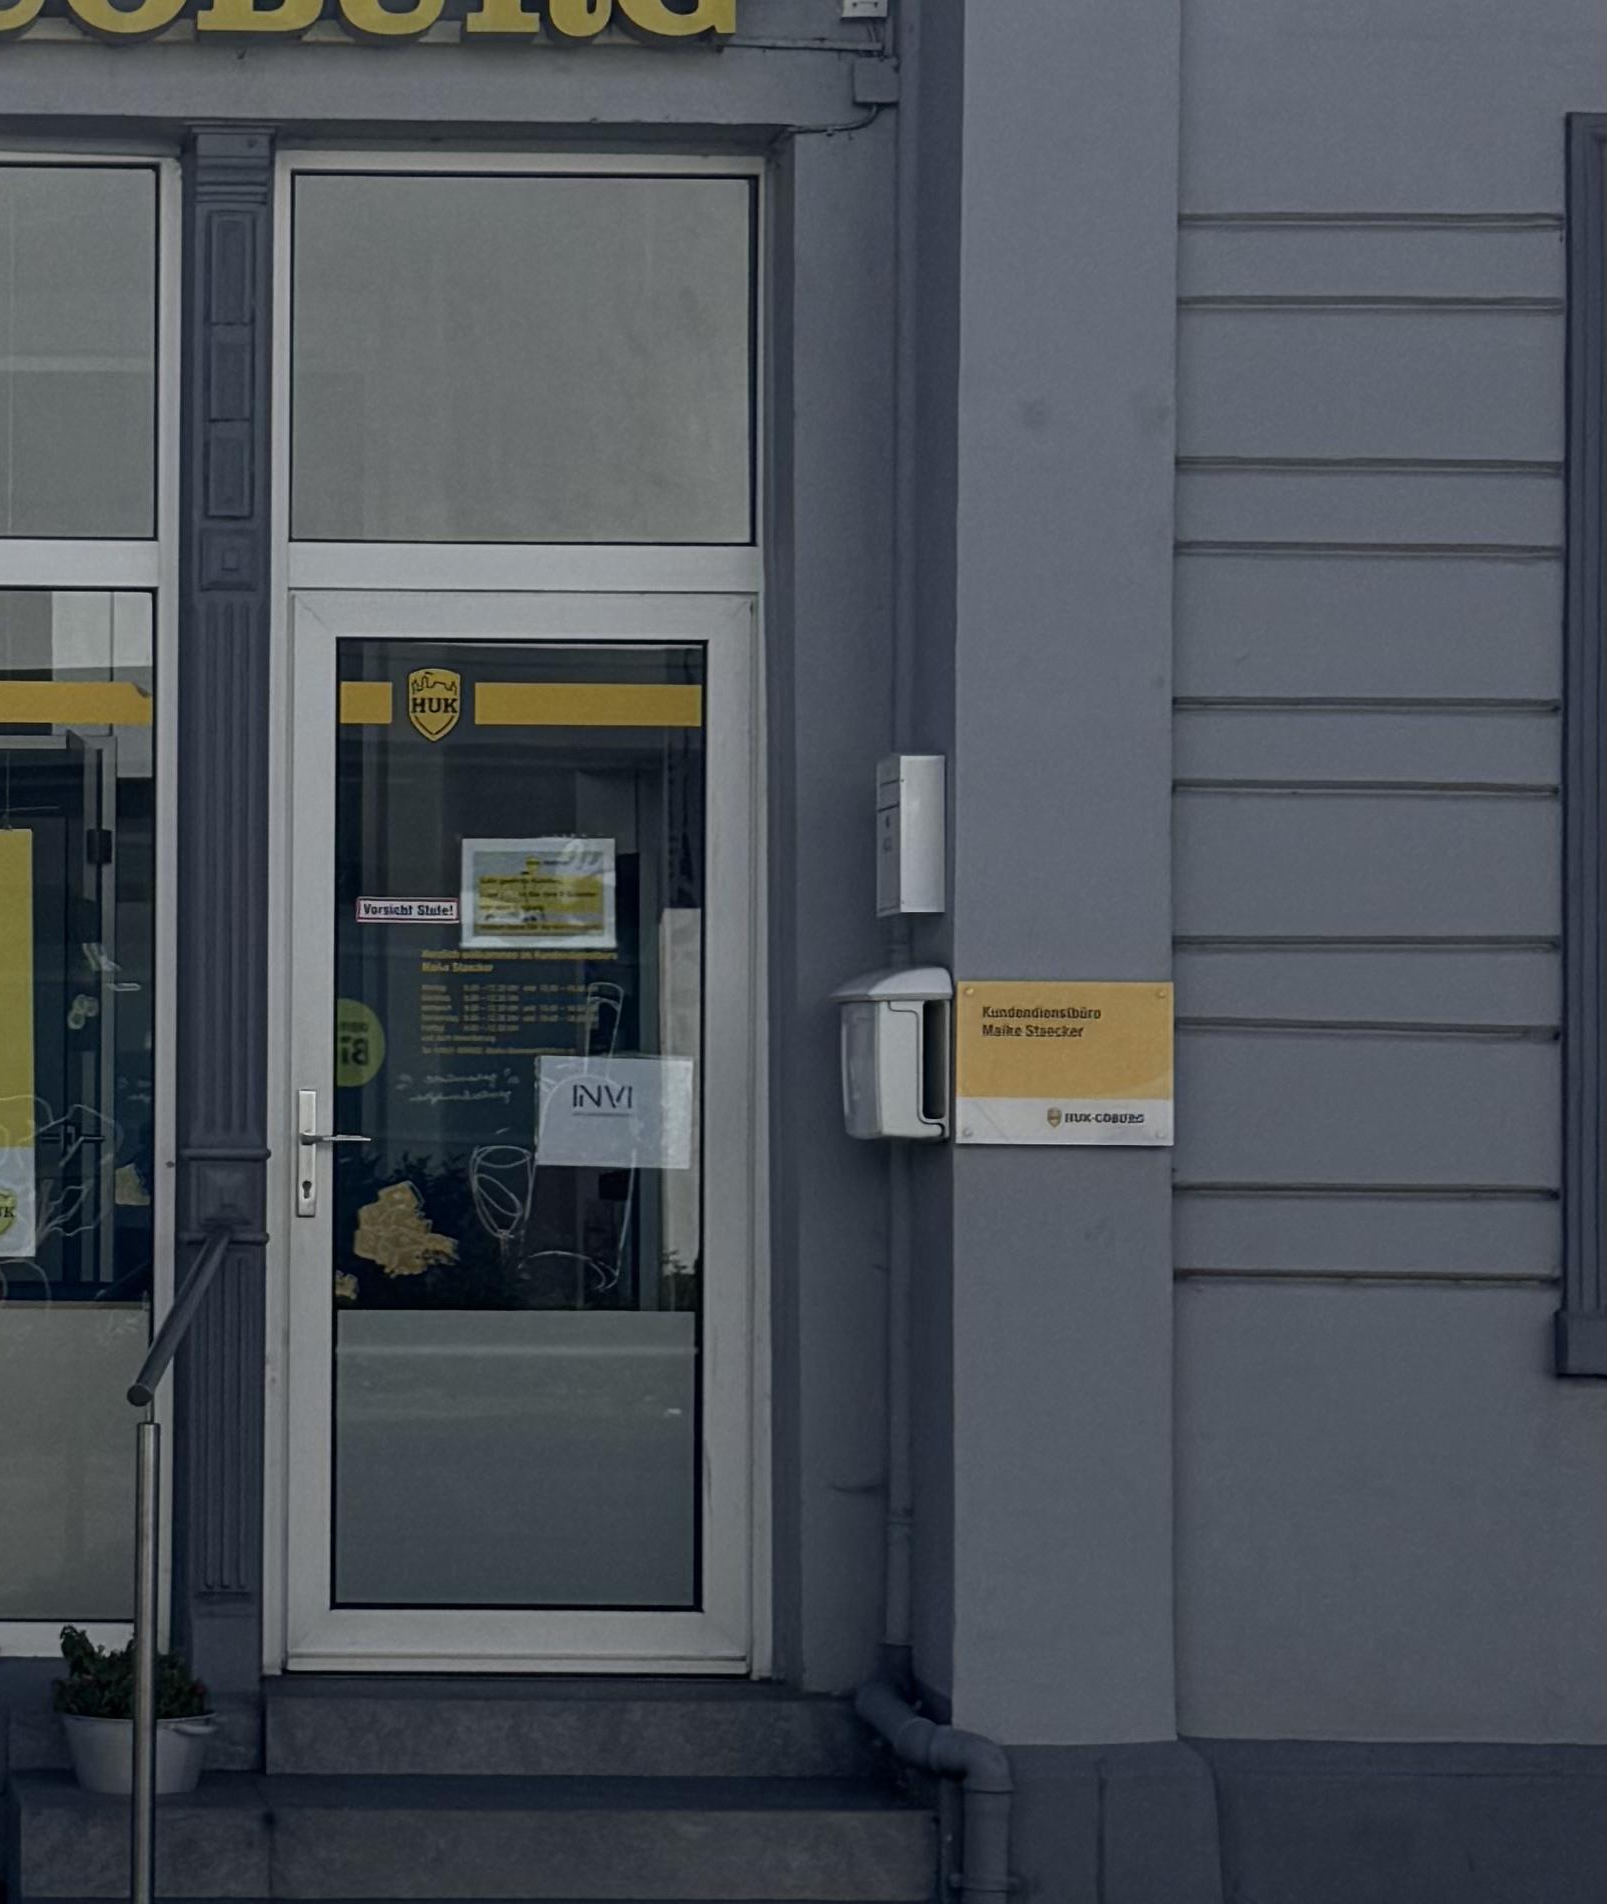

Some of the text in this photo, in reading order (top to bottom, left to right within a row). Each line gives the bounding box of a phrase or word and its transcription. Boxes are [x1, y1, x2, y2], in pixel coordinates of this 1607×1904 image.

[410, 696, 458, 715] HUK
[363, 903, 413, 916] Vorsicht
[982, 1006, 1102, 1019] Kundendienstbüro
